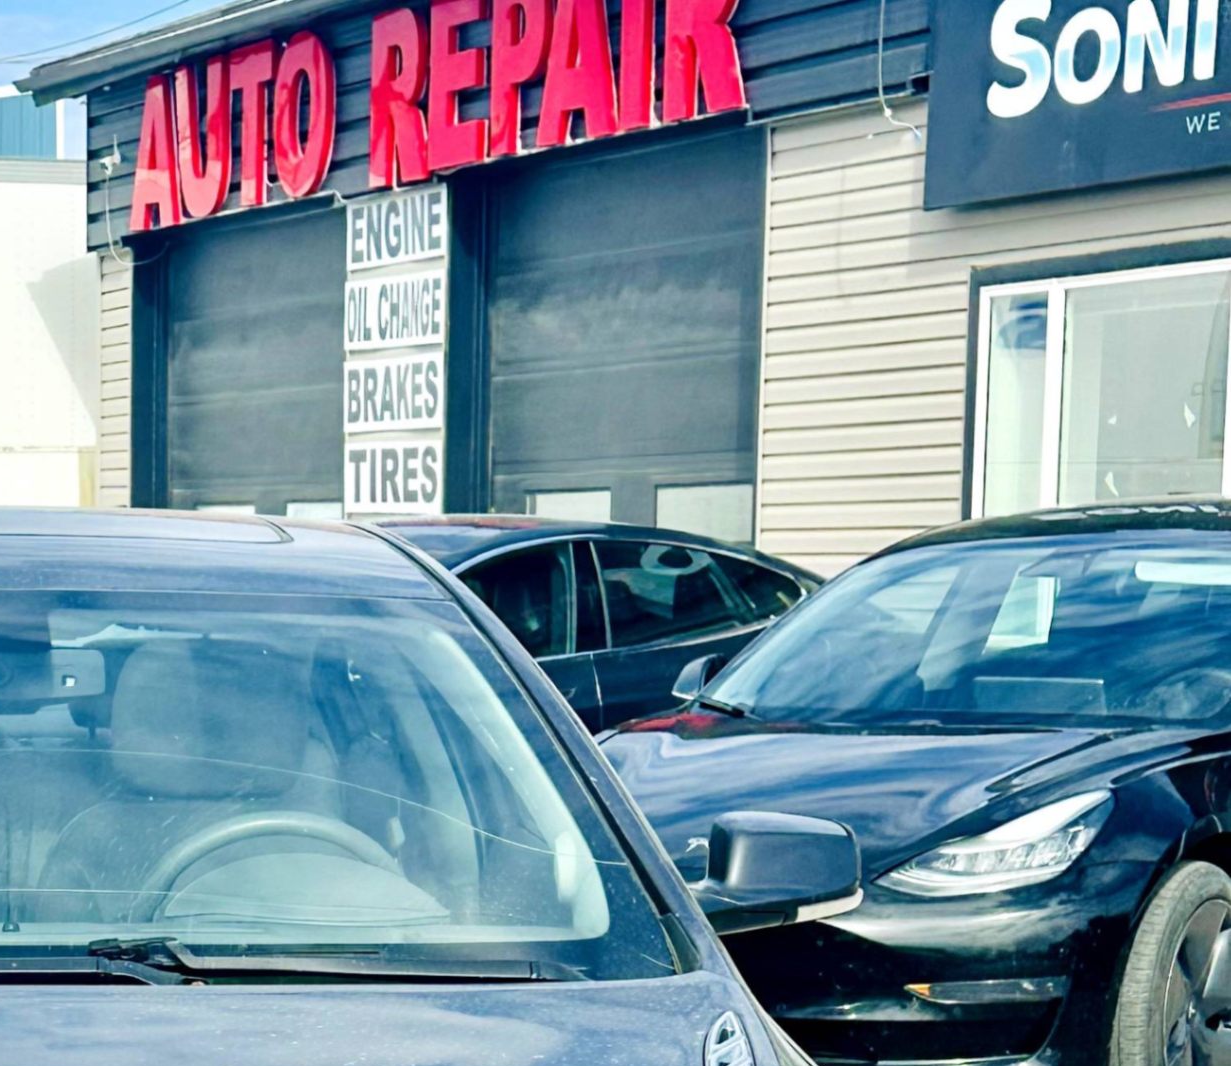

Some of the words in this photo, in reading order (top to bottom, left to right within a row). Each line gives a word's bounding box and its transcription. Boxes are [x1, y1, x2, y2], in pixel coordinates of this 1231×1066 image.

[129, 31, 337, 231] AUTO
[369, 0, 746, 188] REPAIR
[1186, 111, 1220, 134] WE
[351, 191, 442, 264] ENGINE
[347, 286, 372, 343] OIL
[378, 278, 441, 340] CHANGE
[348, 360, 438, 423] BRAKES
[349, 446, 437, 503] TIRES
